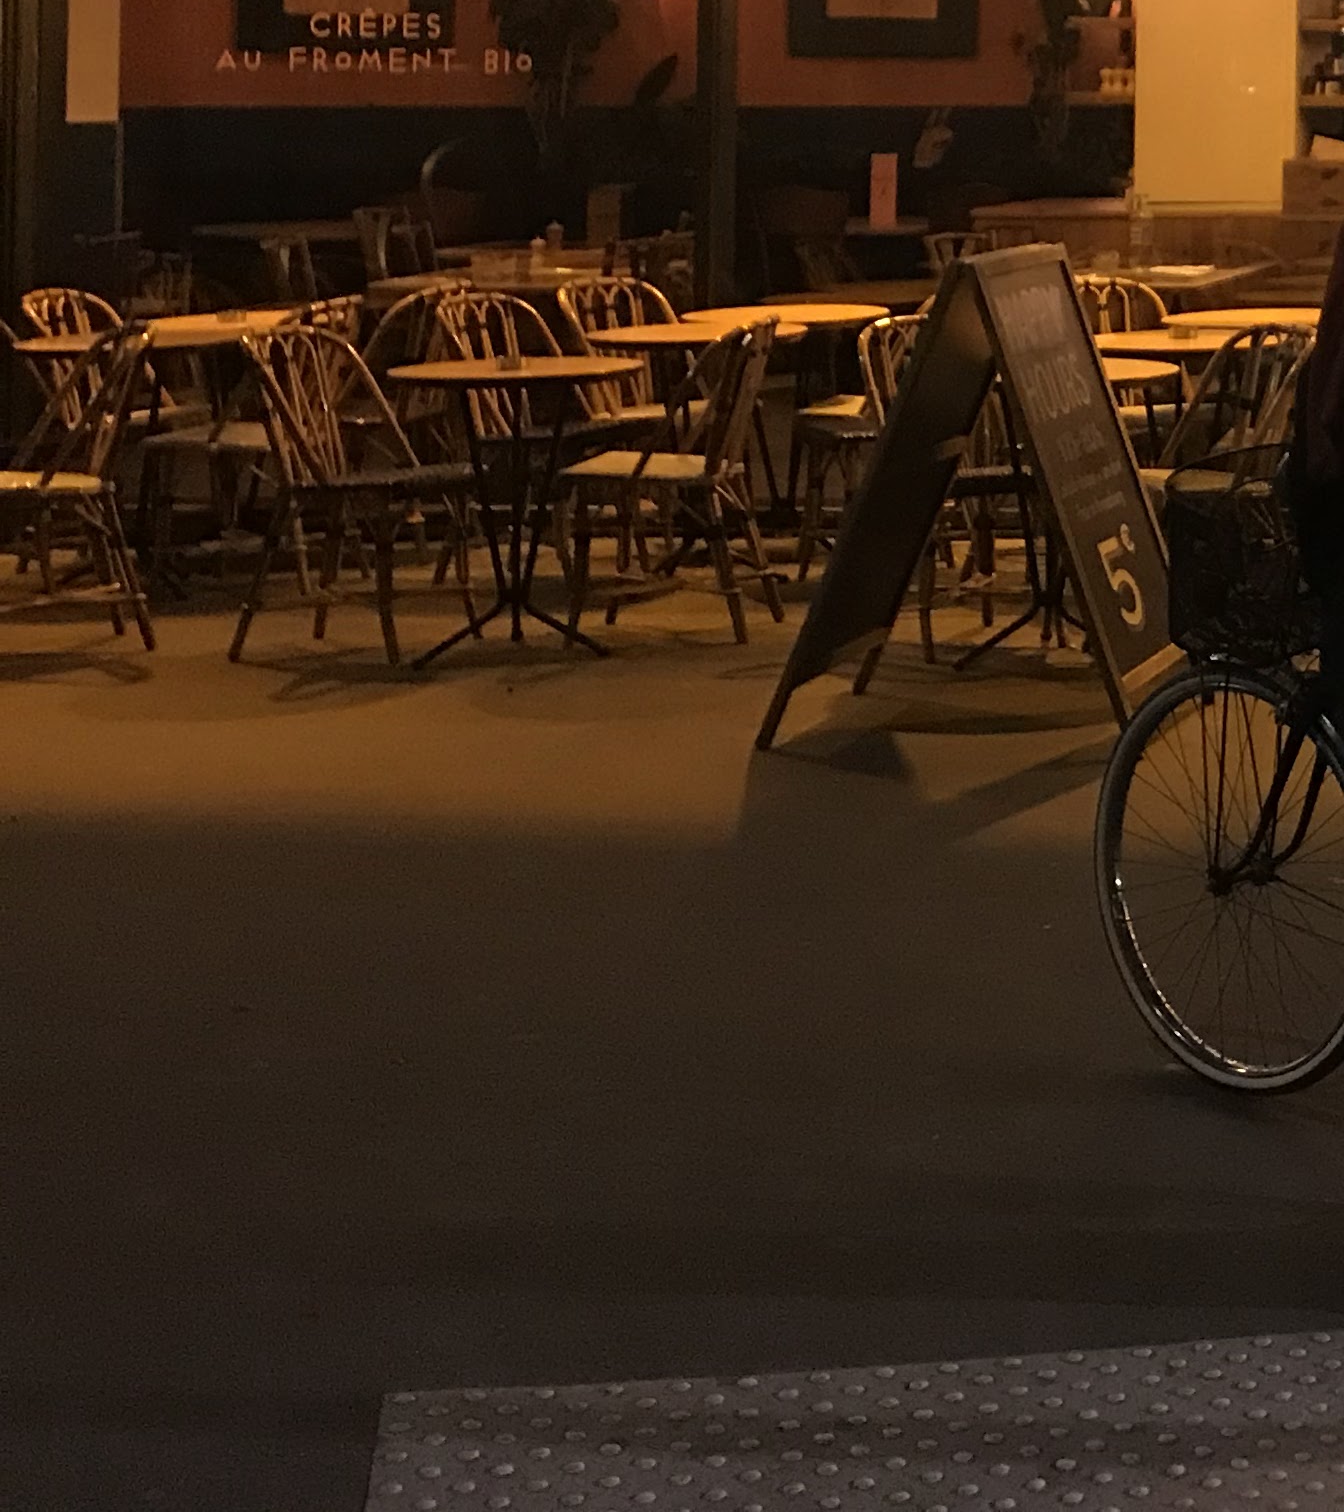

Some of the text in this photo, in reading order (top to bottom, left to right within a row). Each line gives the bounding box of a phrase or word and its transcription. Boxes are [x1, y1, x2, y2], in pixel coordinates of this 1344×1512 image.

[310, 8, 441, 39] CRÊPES
[215, 46, 533, 75] AU FROMENT BIO
